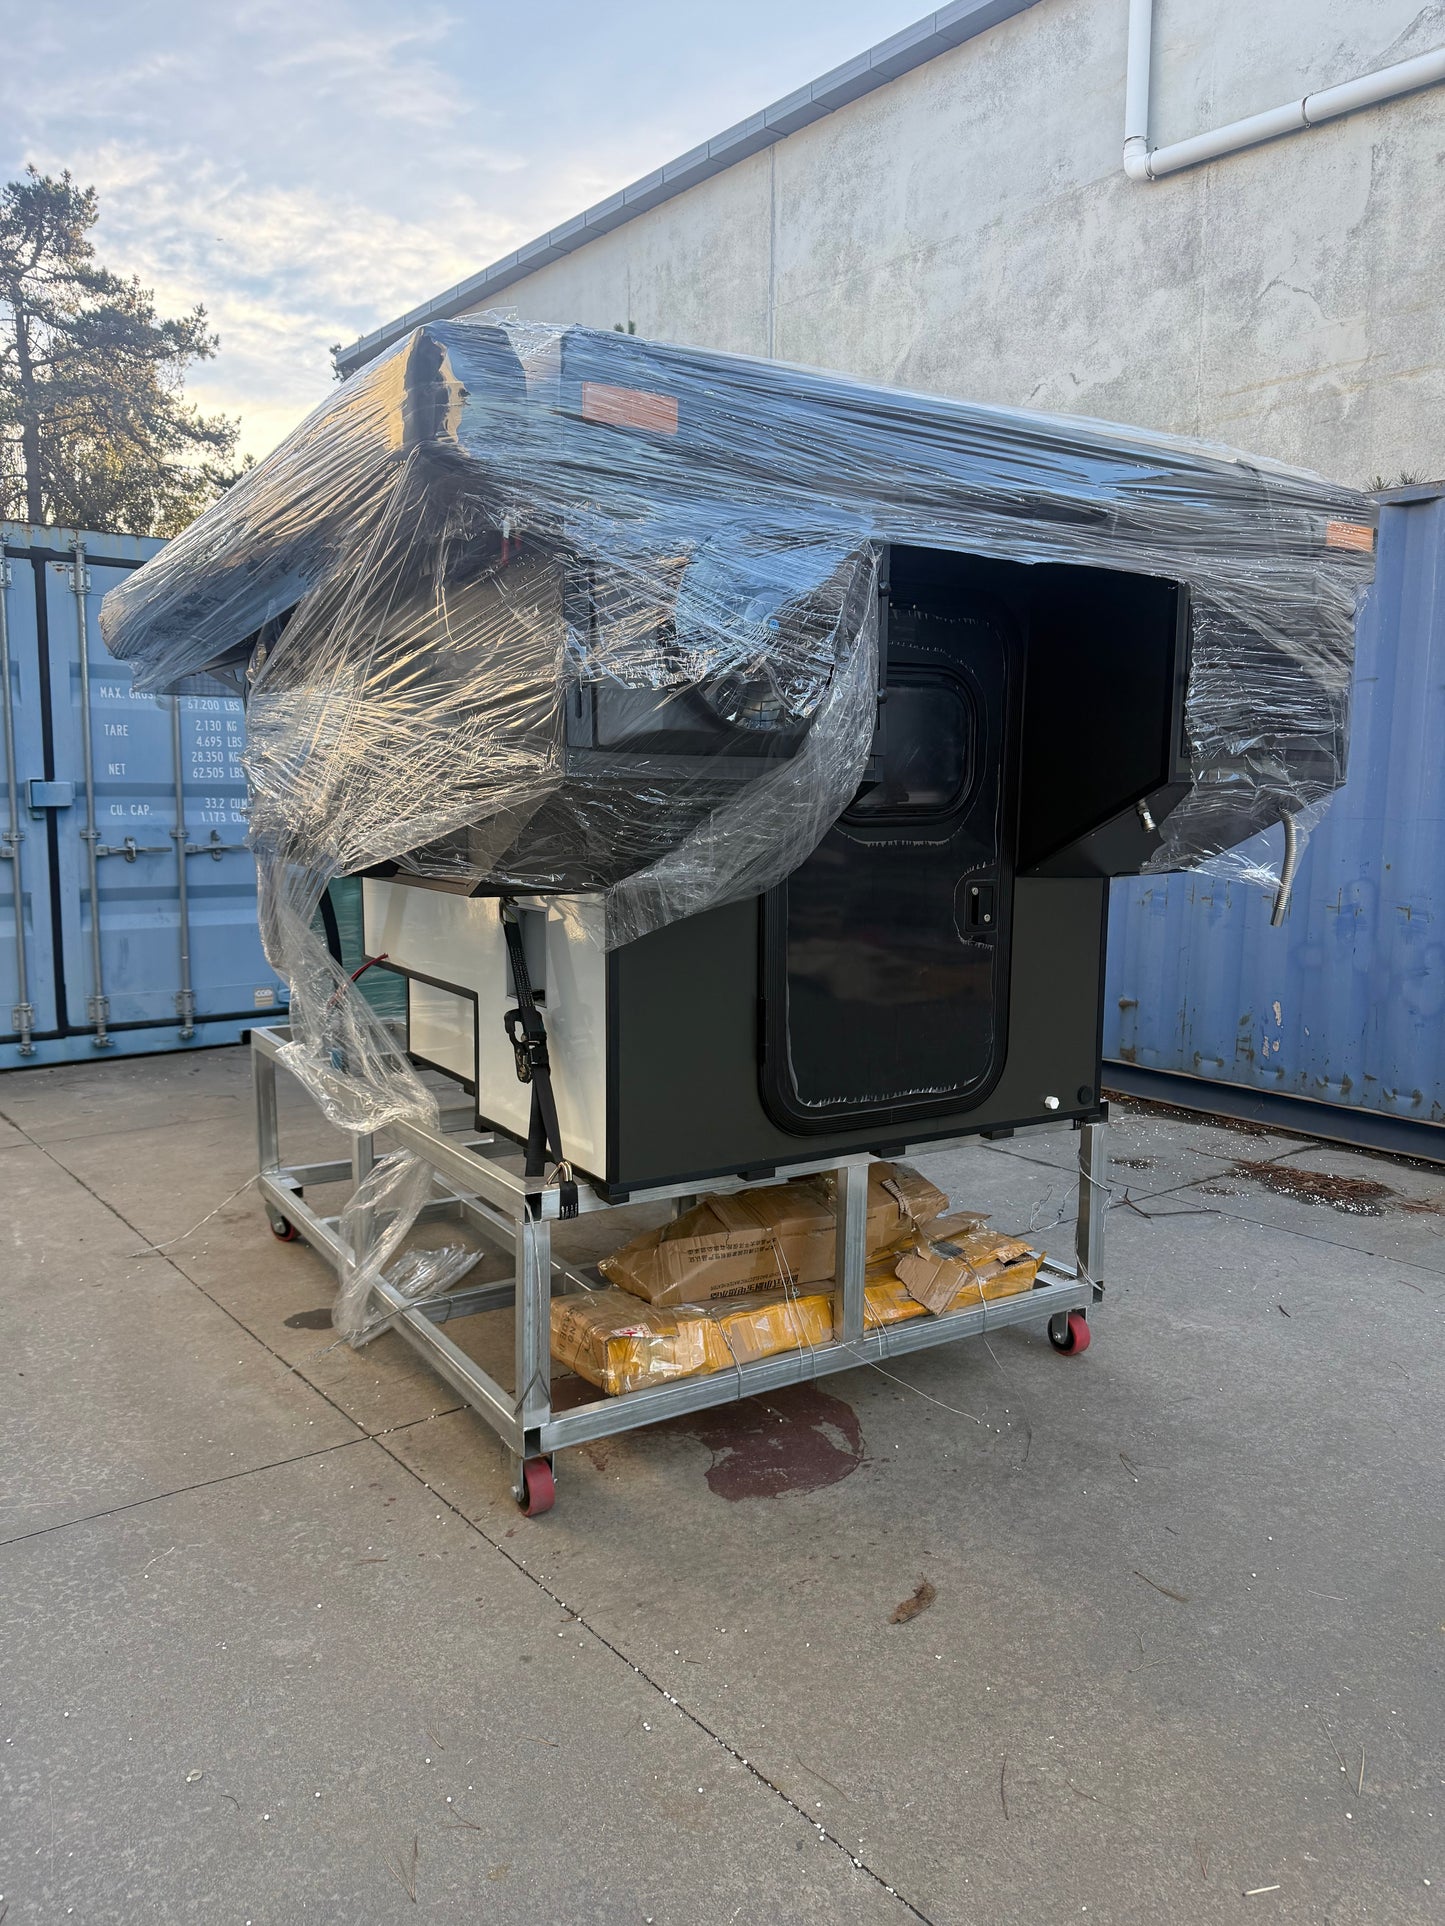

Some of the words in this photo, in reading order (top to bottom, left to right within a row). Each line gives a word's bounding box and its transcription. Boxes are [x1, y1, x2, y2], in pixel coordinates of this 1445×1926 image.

[100, 686, 124, 699] MAX.
[129, 688, 156, 699] GROS
[188, 699, 219, 711] 67.200
[224, 700, 240, 711] LBS
[104, 724, 128, 736] TARE
[196, 720, 221, 731] 2.130
[227, 720, 237, 732] KG
[196, 736, 222, 747] 4.695
[228, 736, 242, 747] LBS
[192, 752, 223, 762] 28.350
[228, 752, 239, 762] KG
[108, 764, 126, 775] NET
[193, 767, 224, 778] 62.505
[230, 767, 244, 778] LBS
[205, 798, 224, 808] 33.2
[110, 804, 126, 815] CU.
[130, 804, 152, 815] CAP.
[202, 812, 226, 822] 1.173
